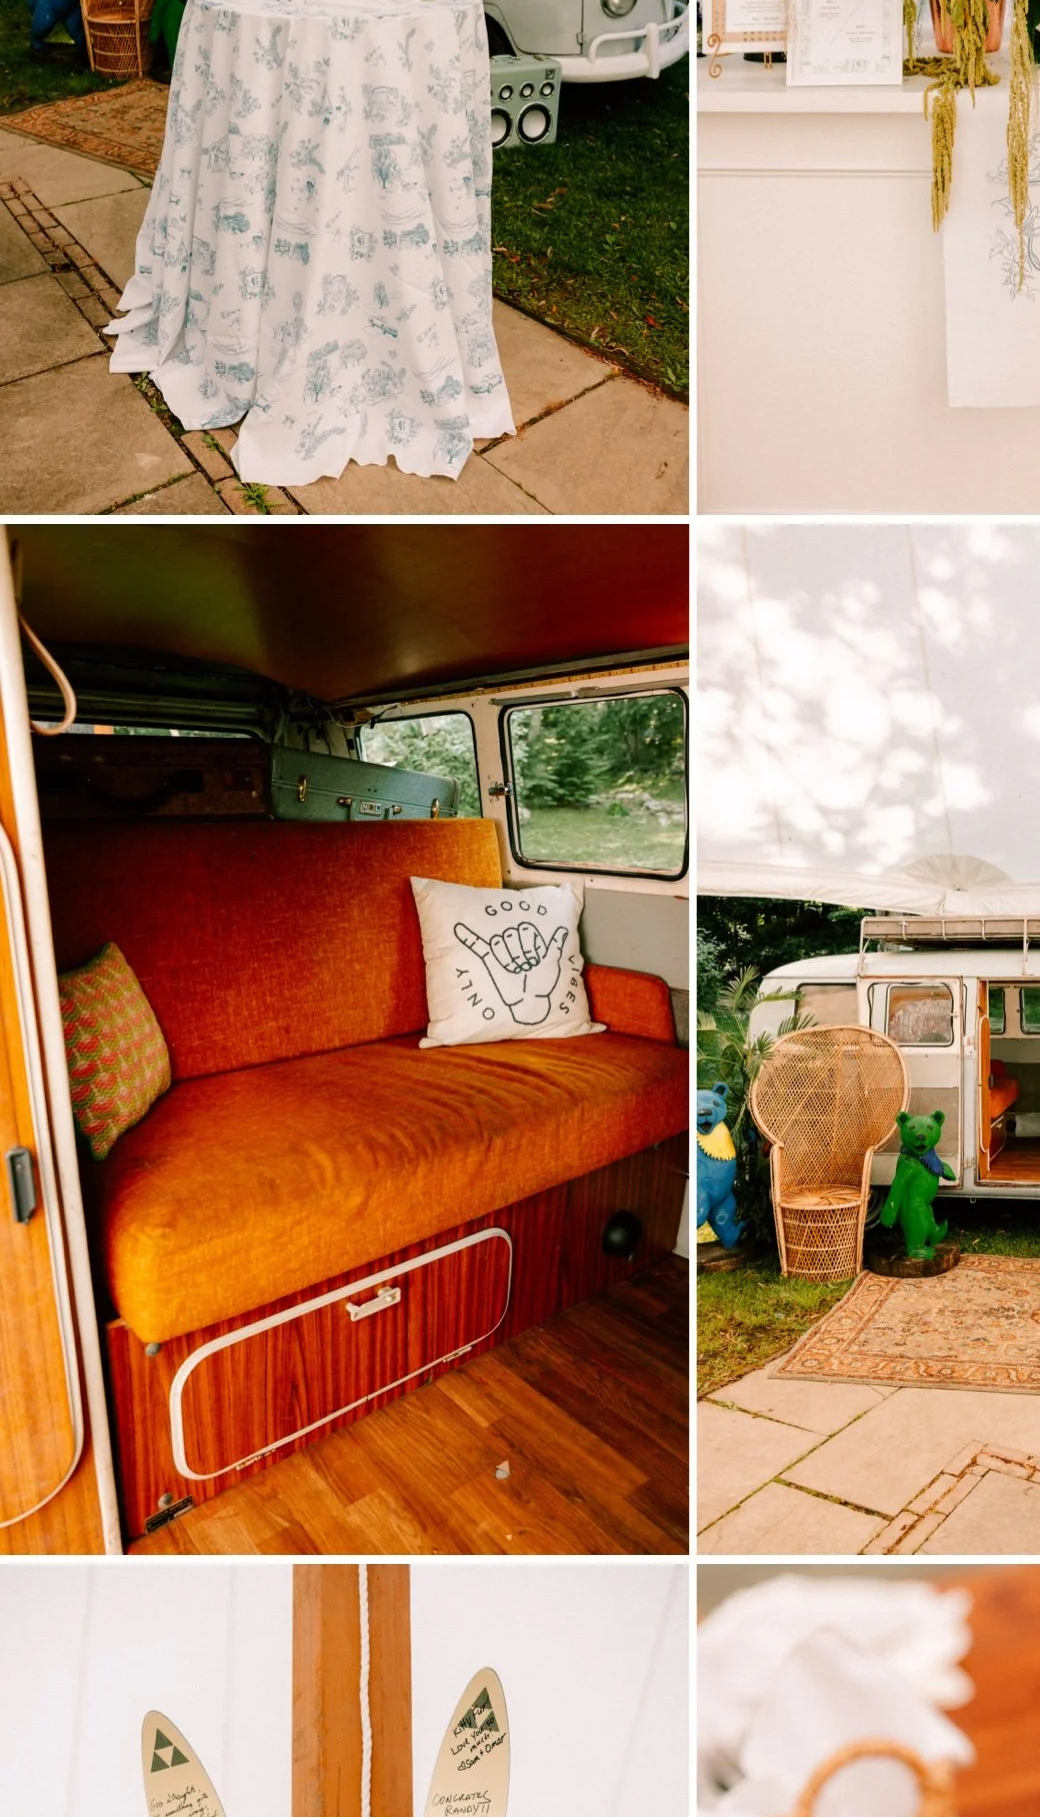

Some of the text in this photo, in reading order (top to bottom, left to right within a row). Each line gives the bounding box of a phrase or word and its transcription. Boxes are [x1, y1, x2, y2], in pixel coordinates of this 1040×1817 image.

[485, 901, 548, 916] GOOD
[456, 967, 496, 1020] ONLY
[559, 955, 583, 1015] VIBES
[450, 1716, 495, 1755] Love you so
[453, 1716, 472, 1738] Kitty
[466, 1732, 506, 1769] Sam Omar
